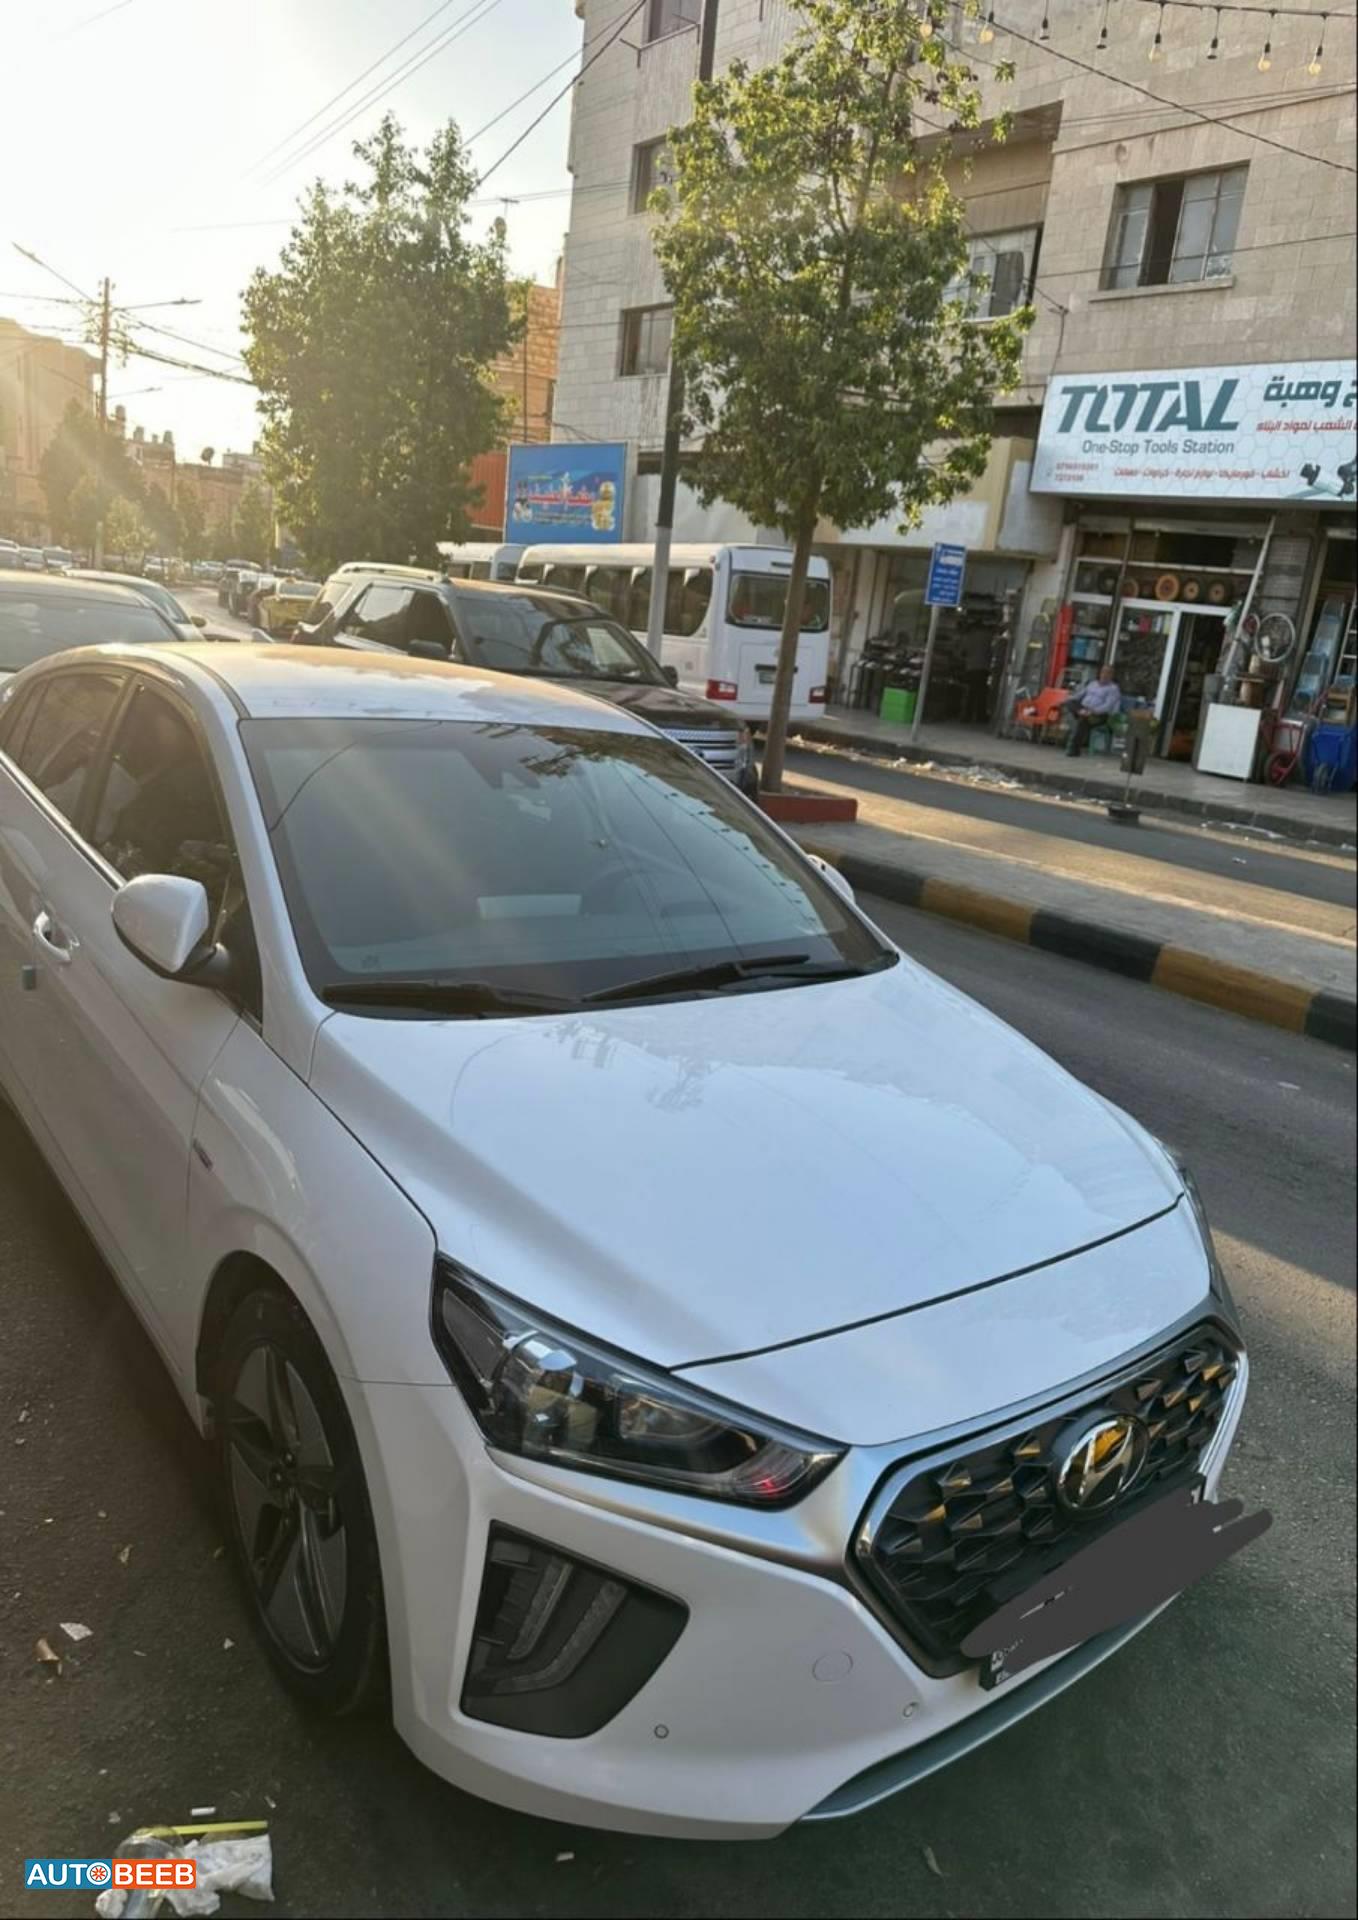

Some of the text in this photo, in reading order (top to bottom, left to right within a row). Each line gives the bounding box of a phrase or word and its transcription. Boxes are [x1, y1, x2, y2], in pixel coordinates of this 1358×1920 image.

[1263, 376, 1342, 408] وهبة
[1058, 379, 1240, 433] TOTAL
[1256, 420, 1282, 433] البناء
[1283, 420, 1312, 434] لمواد
[1082, 438, 1235, 456] One-Stop Tools Station
